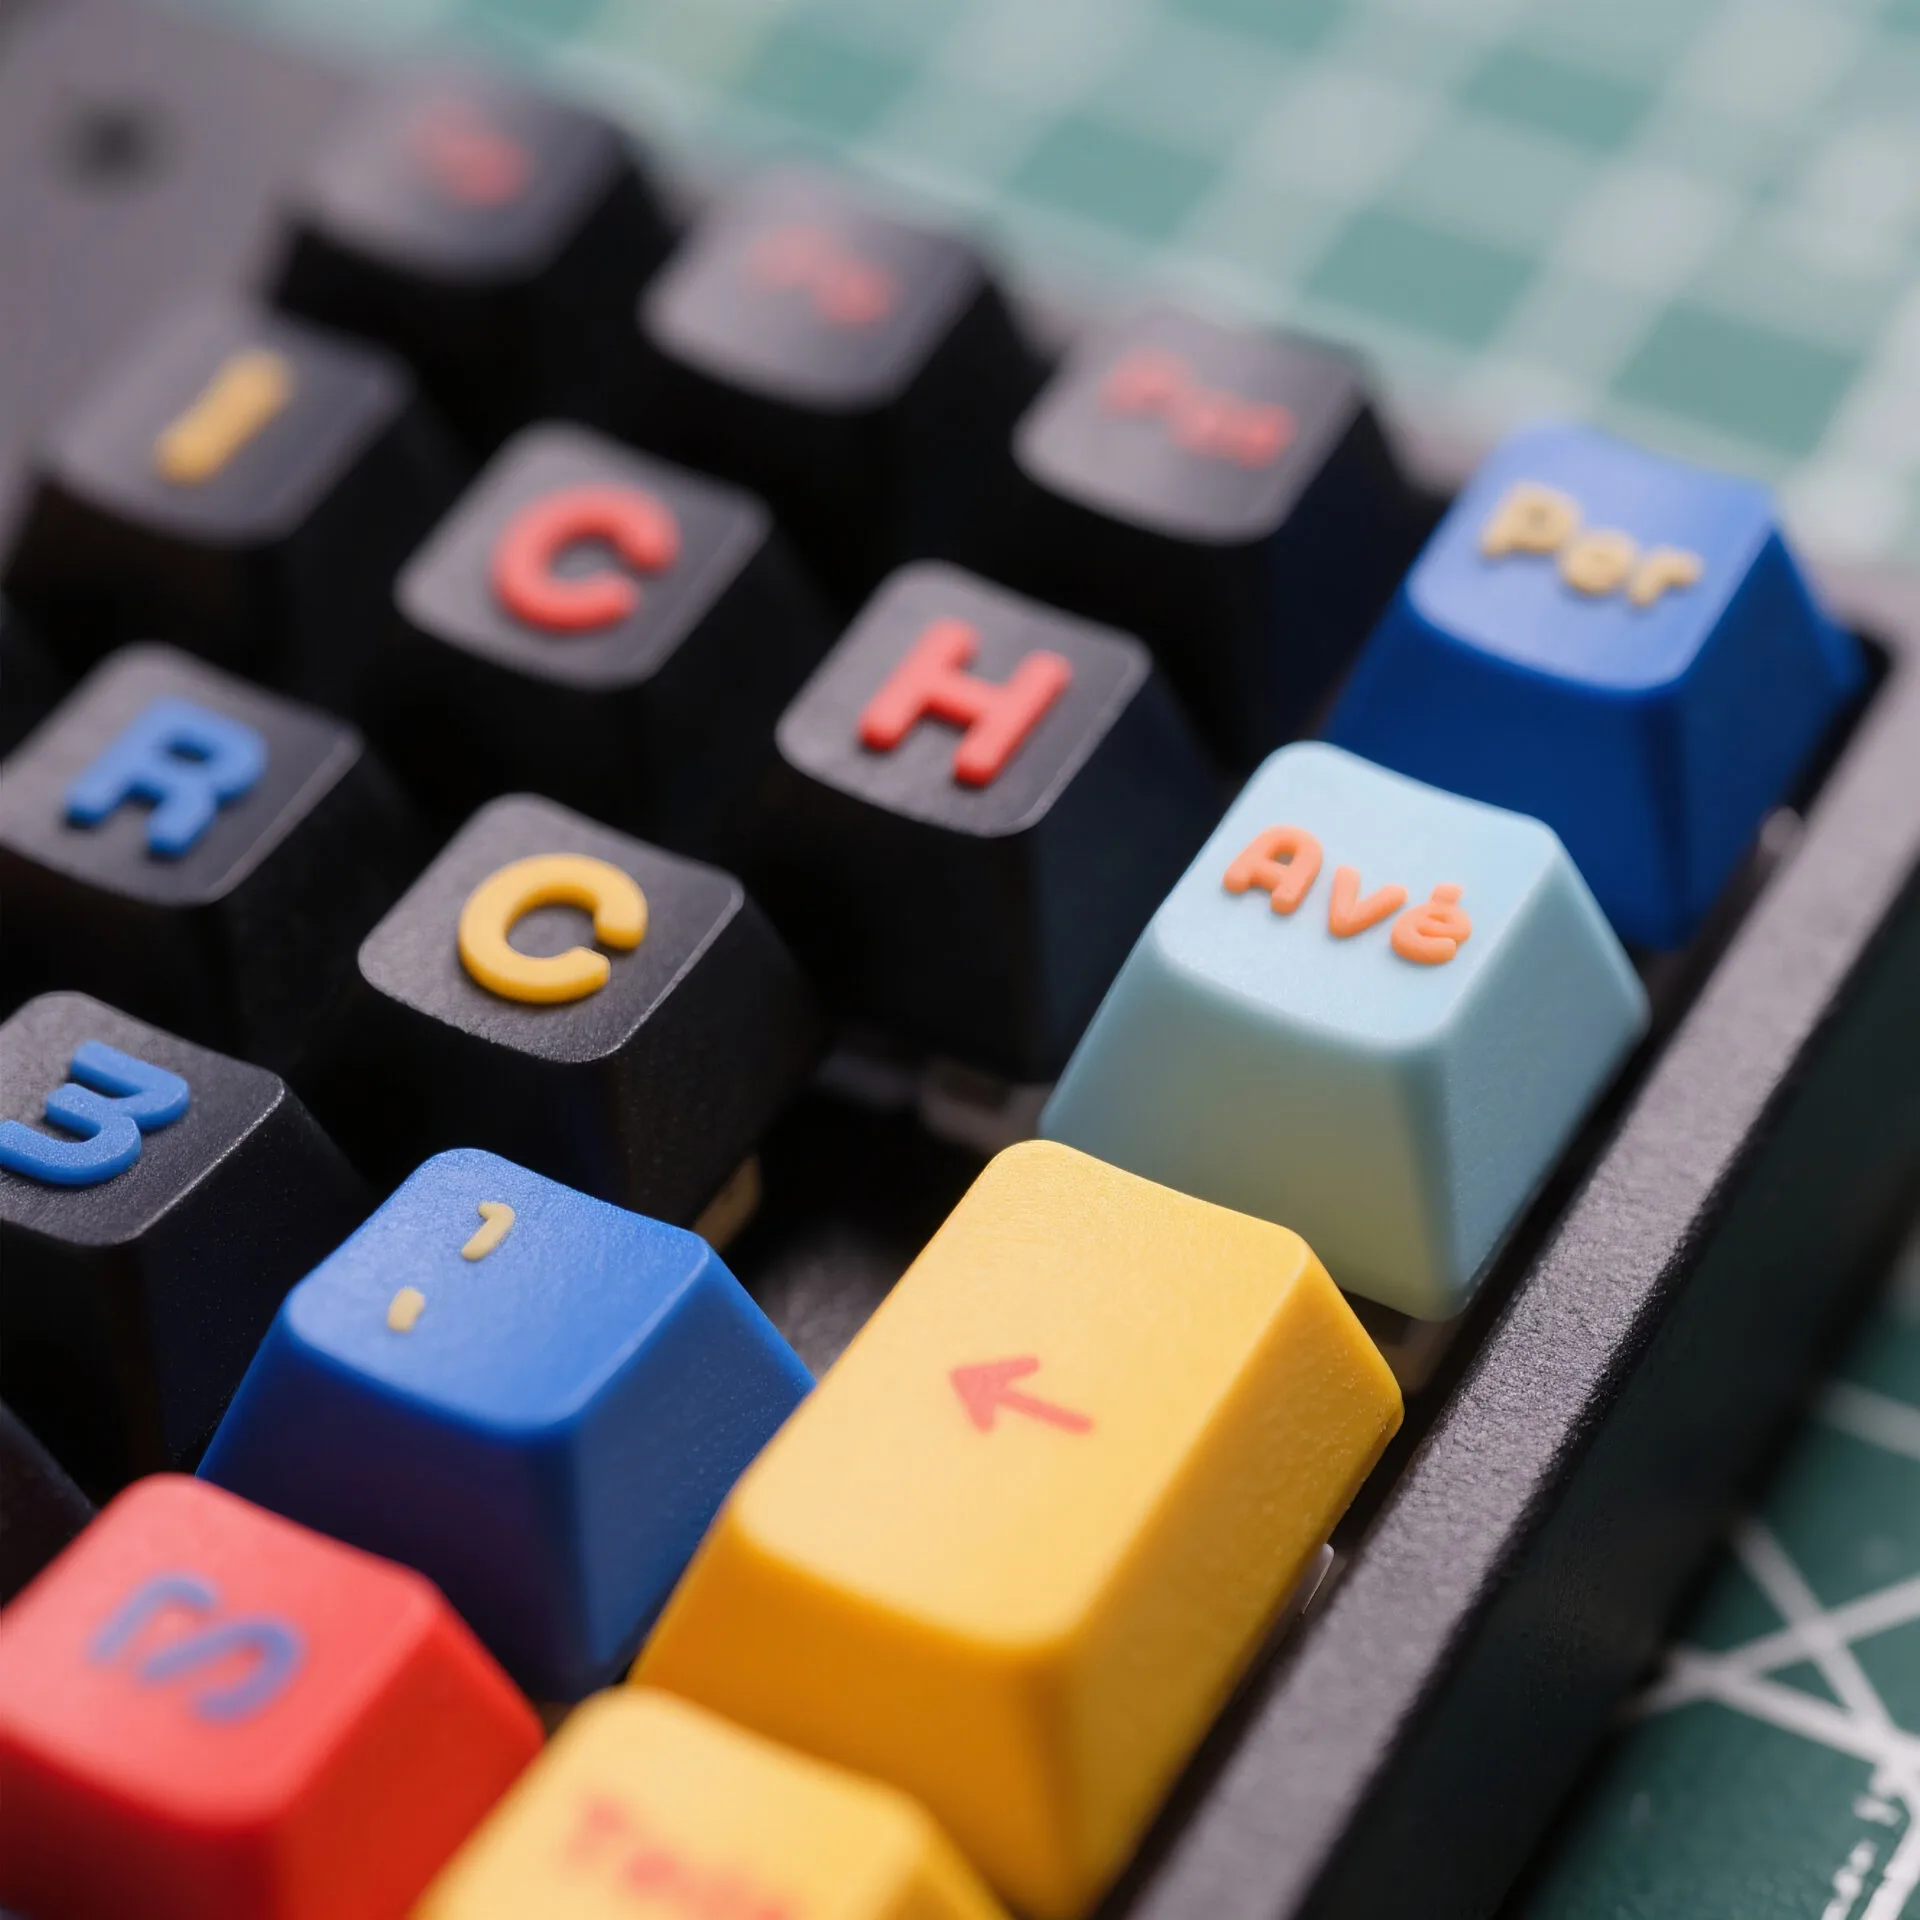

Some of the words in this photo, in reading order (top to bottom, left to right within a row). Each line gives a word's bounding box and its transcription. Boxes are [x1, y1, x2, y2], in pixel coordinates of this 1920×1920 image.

[491, 482, 680, 636] C
[65, 700, 268, 858] R
[858, 617, 1073, 786] H
[458, 853, 648, 1005] C
